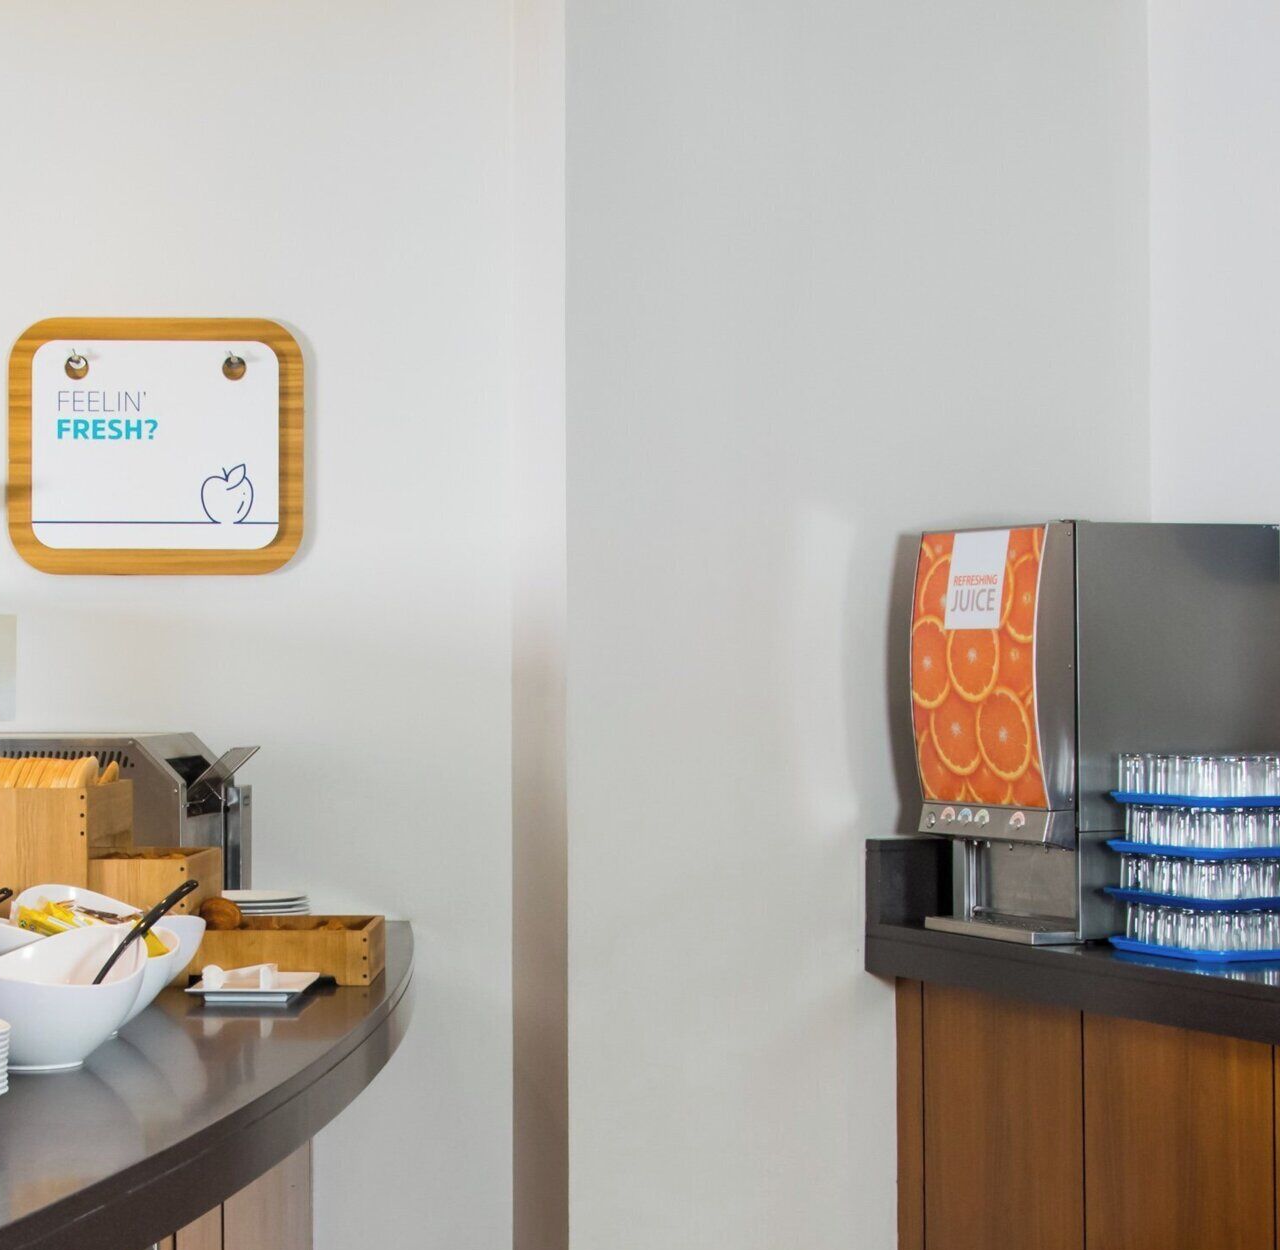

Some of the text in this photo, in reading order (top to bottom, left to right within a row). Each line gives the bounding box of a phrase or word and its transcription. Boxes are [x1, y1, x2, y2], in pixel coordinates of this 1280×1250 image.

[57, 390, 147, 412] FEELIN'
[56, 418, 159, 440] FRESH?
[953, 574, 998, 586] REFRESHING
[950, 588, 996, 612] JUICE
